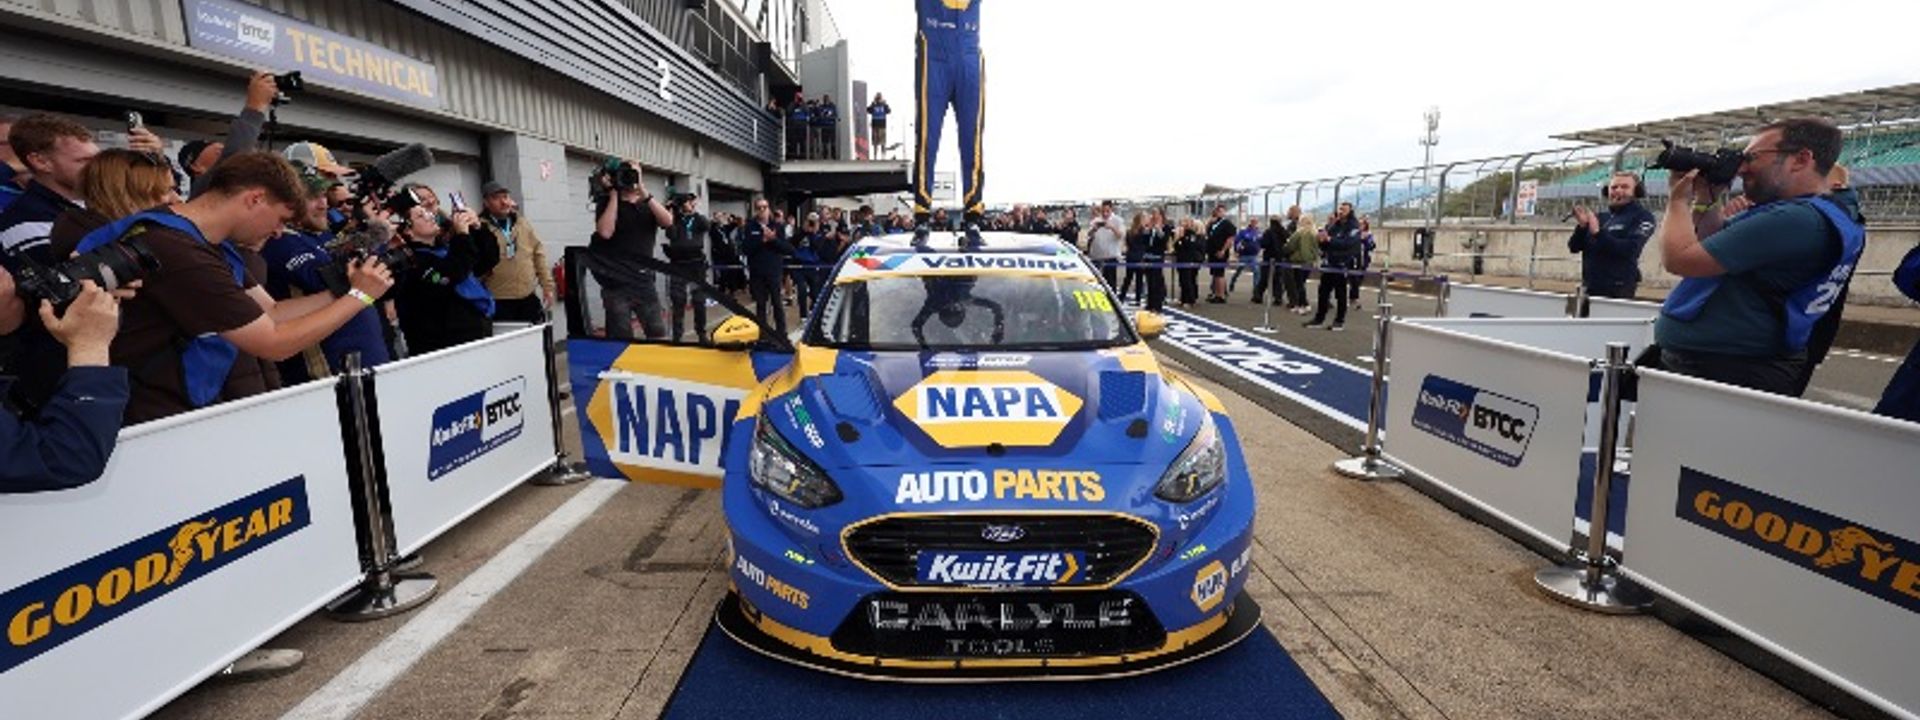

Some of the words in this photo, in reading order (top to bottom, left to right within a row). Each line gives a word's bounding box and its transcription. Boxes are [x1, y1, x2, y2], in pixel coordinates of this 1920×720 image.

[286, 27, 433, 97] TECHNICAL
[658, 59, 671, 100] 2
[485, 392, 522, 426] BTCC
[926, 387, 1058, 418] NAPA
[1473, 404, 1525, 443] BTCC
[895, 469, 988, 504] AUTO
[992, 469, 1105, 501] PARTS
[737, 554, 765, 586] AUTO
[765, 575, 810, 609] PARTS
[927, 552, 1062, 582] KwikFit
[868, 600, 1132, 631] CARLYLE
[950, 639, 1054, 653] TOOLS
